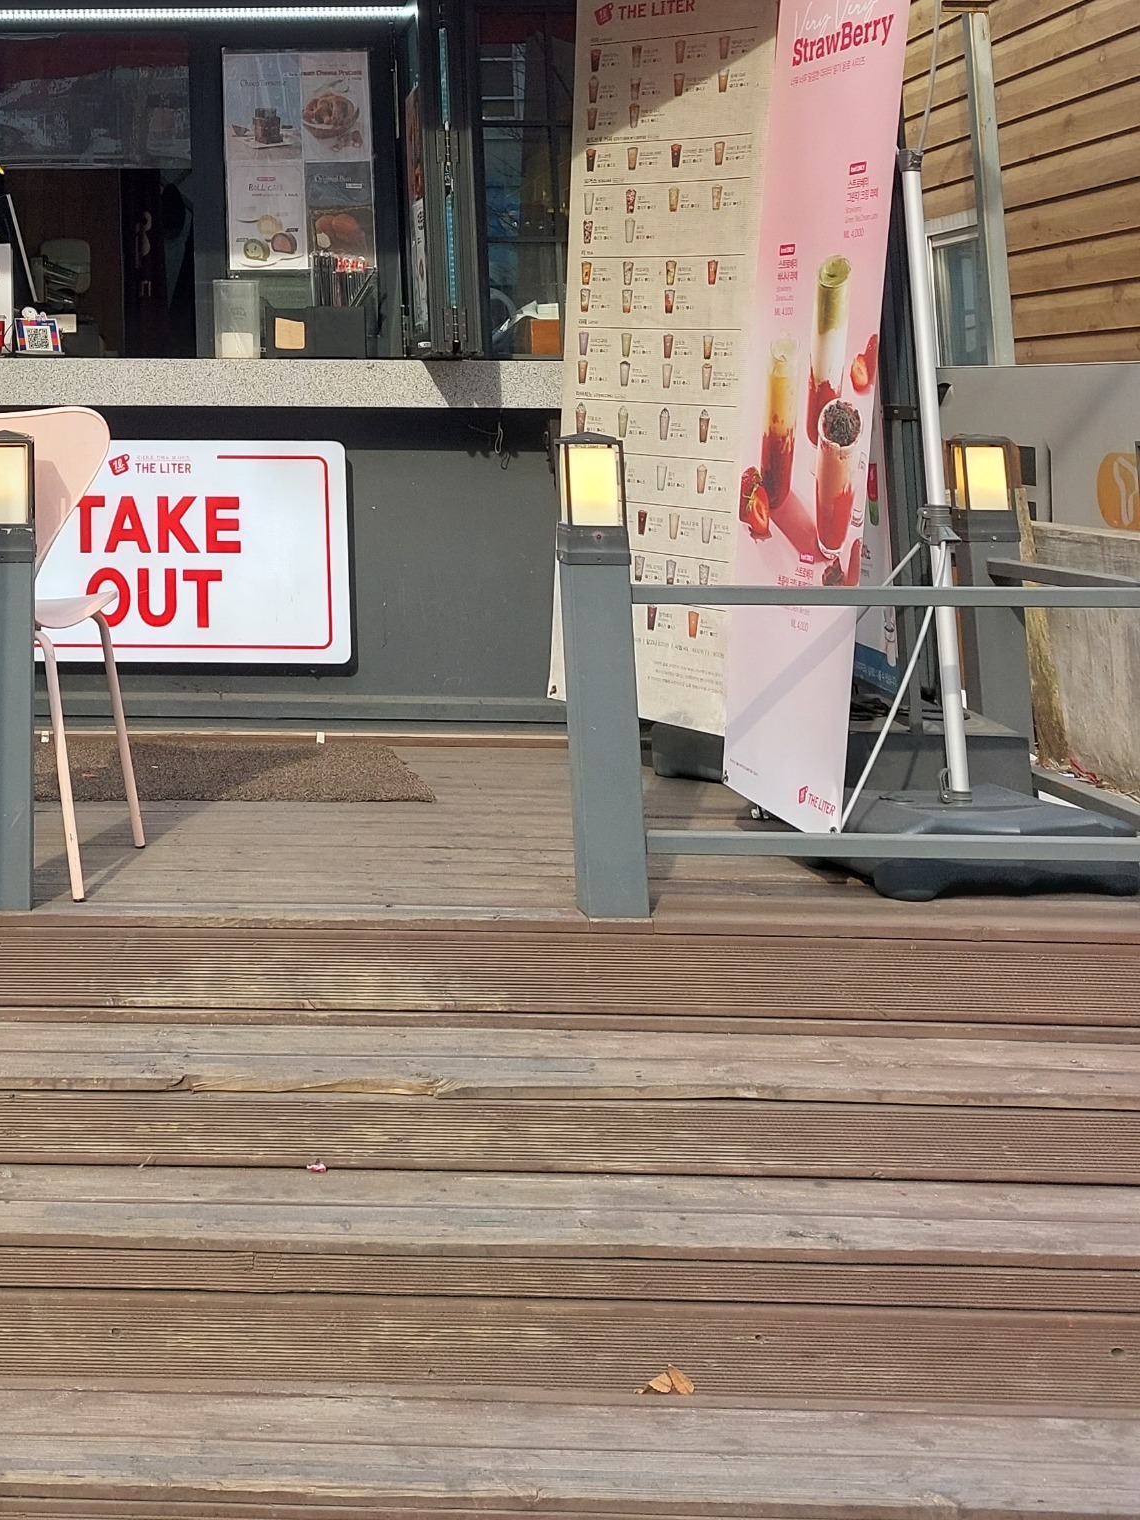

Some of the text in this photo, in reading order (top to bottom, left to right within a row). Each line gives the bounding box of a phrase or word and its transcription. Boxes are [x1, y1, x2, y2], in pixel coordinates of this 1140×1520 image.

[618, 3, 647, 21] THE
[792, 13, 895, 67] StrawBerry
[135, 463, 192, 474] THE LITER
[76, 496, 241, 554] TAKE
[86, 567, 222, 628] OUT
[808, 793, 836, 817] THE LITER
